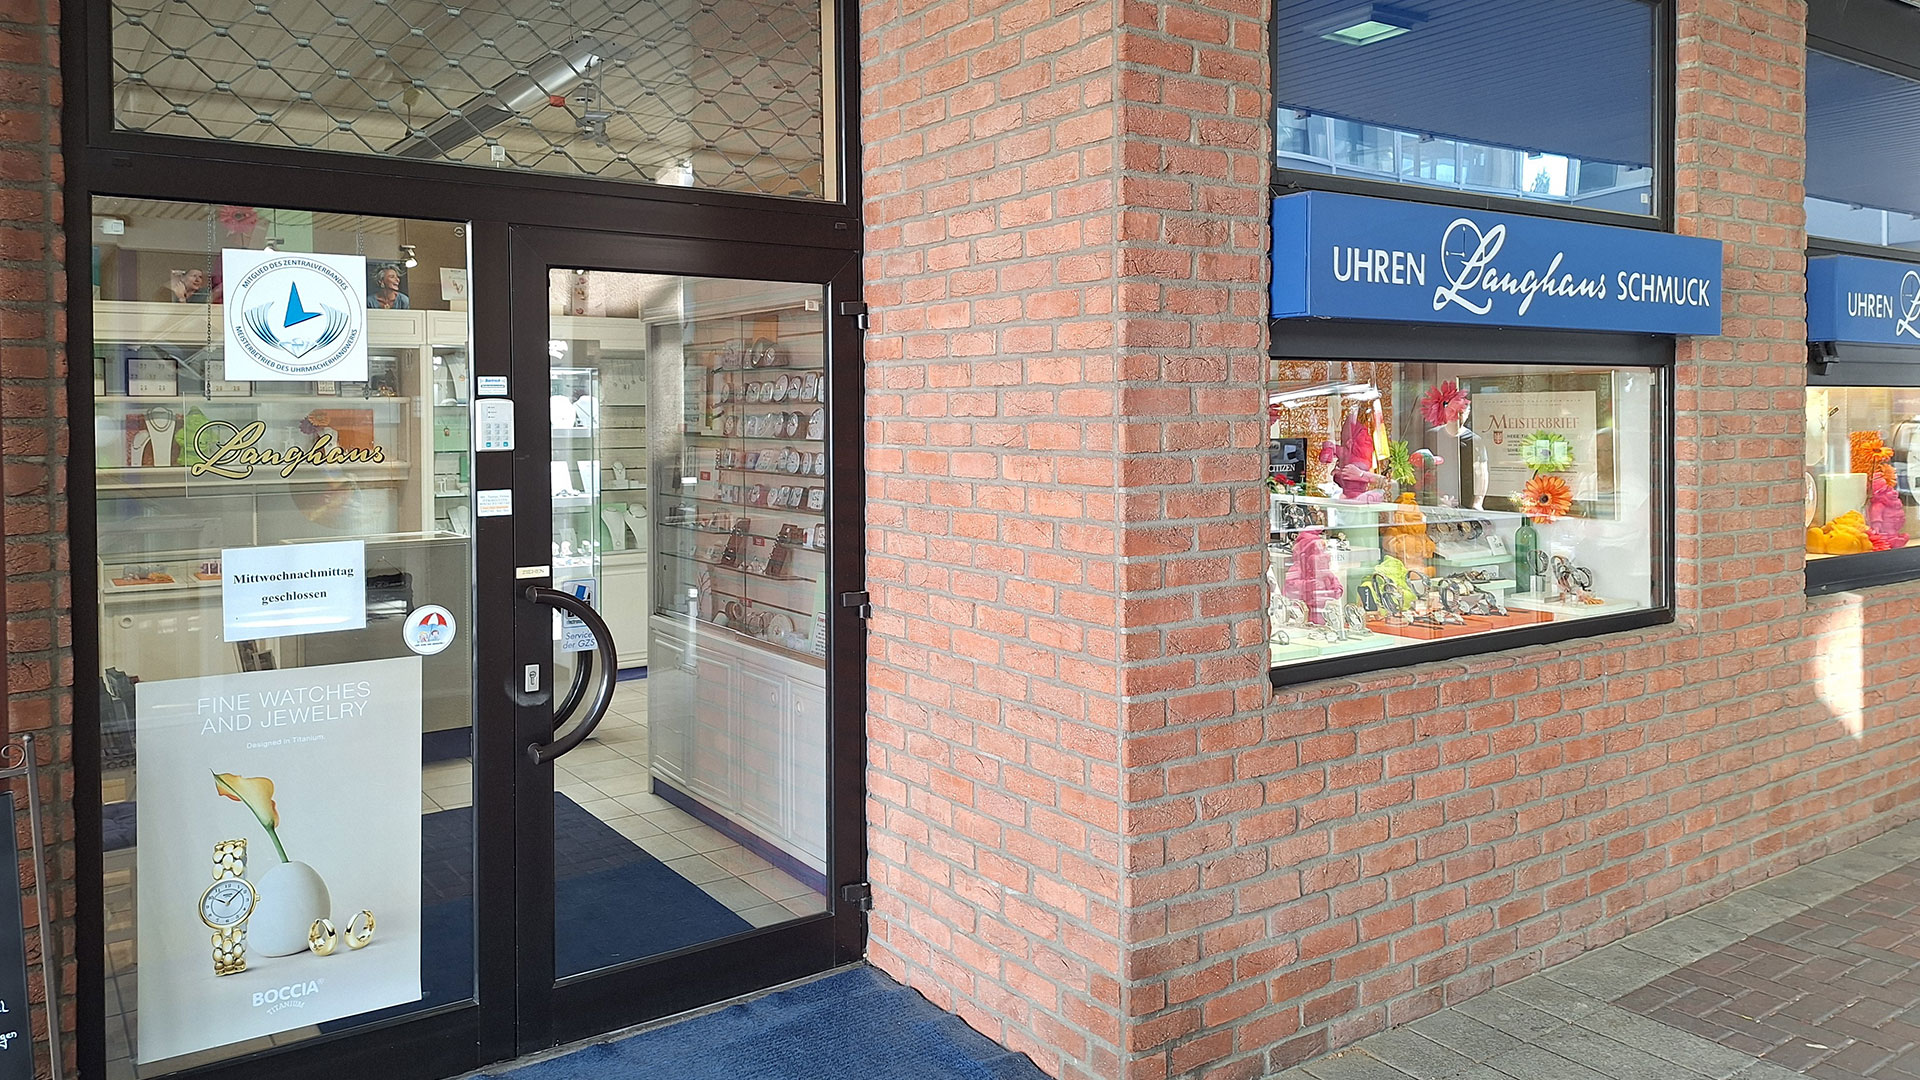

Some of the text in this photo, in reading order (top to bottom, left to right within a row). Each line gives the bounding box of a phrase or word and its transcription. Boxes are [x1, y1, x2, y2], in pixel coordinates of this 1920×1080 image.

[242, 259, 349, 291] MITGLIED DES ZENTRALVERBANDES
[1332, 246, 1426, 286] UHREN
[1617, 270, 1711, 308] SCHMUCK
[1848, 291, 1894, 319] UHREN
[235, 325, 358, 373] MEISTERBETRIEB DES UHRMACHERHANDWERKS
[1268, 463, 1296, 473] CITIZEN
[233, 567, 355, 585] Mittwochnachmittag
[261, 590, 327, 606] geschlossen
[565, 631, 593, 641] Service
[578, 638, 596, 648] GZS
[197, 681, 372, 716] FINE WATCHES
[200, 700, 369, 736] AND JEWELRY
[246, 737, 282, 750] Designed
